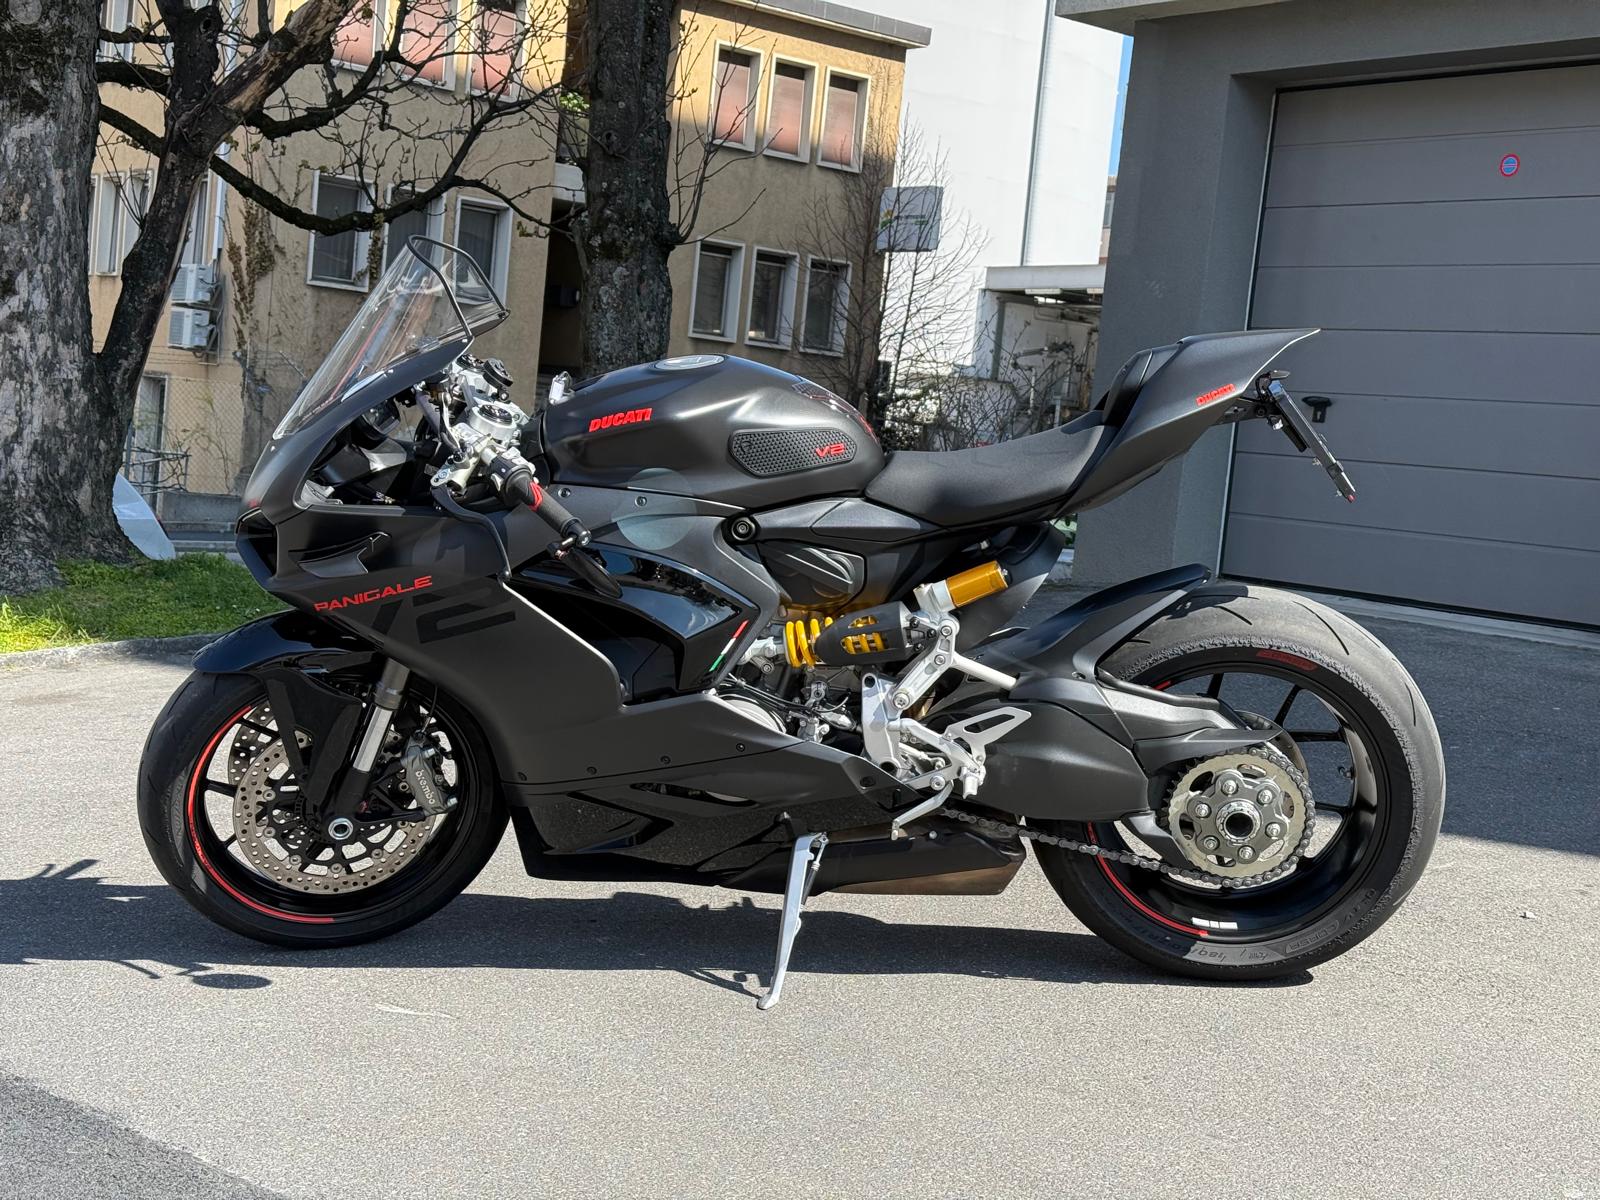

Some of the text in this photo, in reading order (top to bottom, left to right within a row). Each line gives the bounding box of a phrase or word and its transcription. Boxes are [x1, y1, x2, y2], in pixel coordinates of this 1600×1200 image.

[588, 407, 653, 433] DUCATI
[815, 442, 846, 458] V2
[313, 575, 433, 612] PANIGALE
[415, 769, 436, 805] brembo
